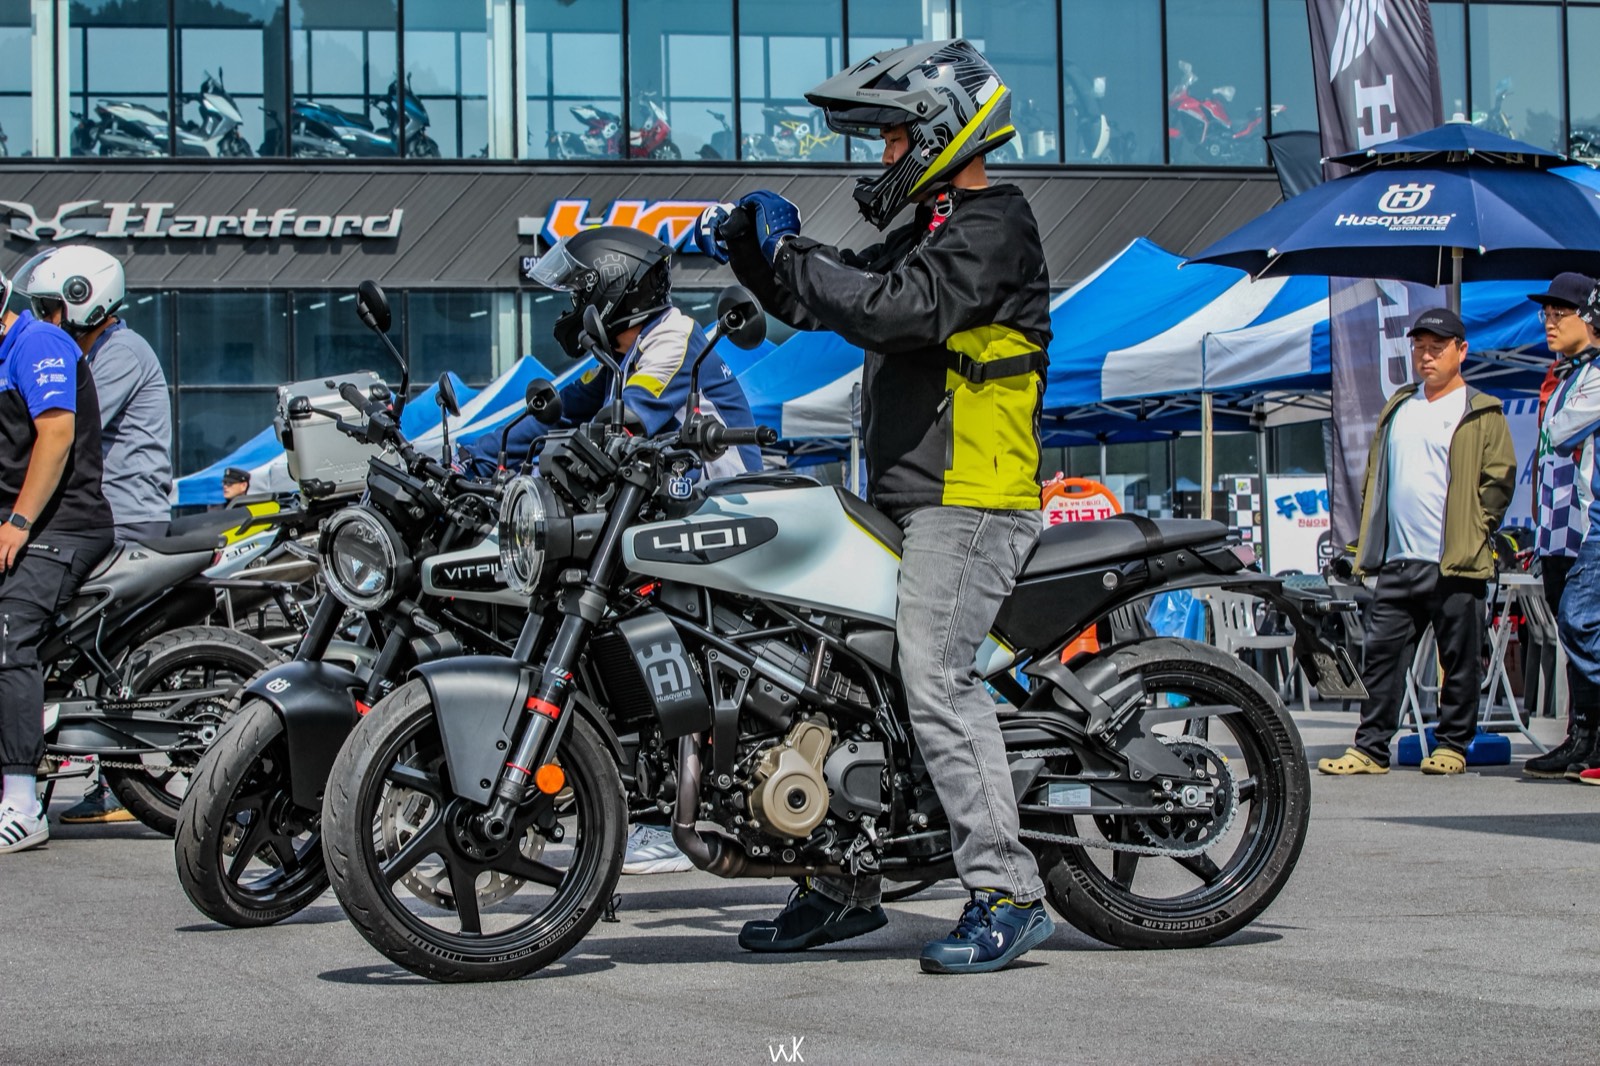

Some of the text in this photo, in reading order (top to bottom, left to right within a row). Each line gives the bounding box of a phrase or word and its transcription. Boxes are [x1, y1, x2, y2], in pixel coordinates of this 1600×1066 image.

[96, 202, 403, 238] Hartford
[1335, 213, 1451, 227] Husqvarna
[652, 526, 748, 552] 401
[538, 919, 574, 948] MICHELIN
[1142, 918, 1206, 930] MICHELIN
